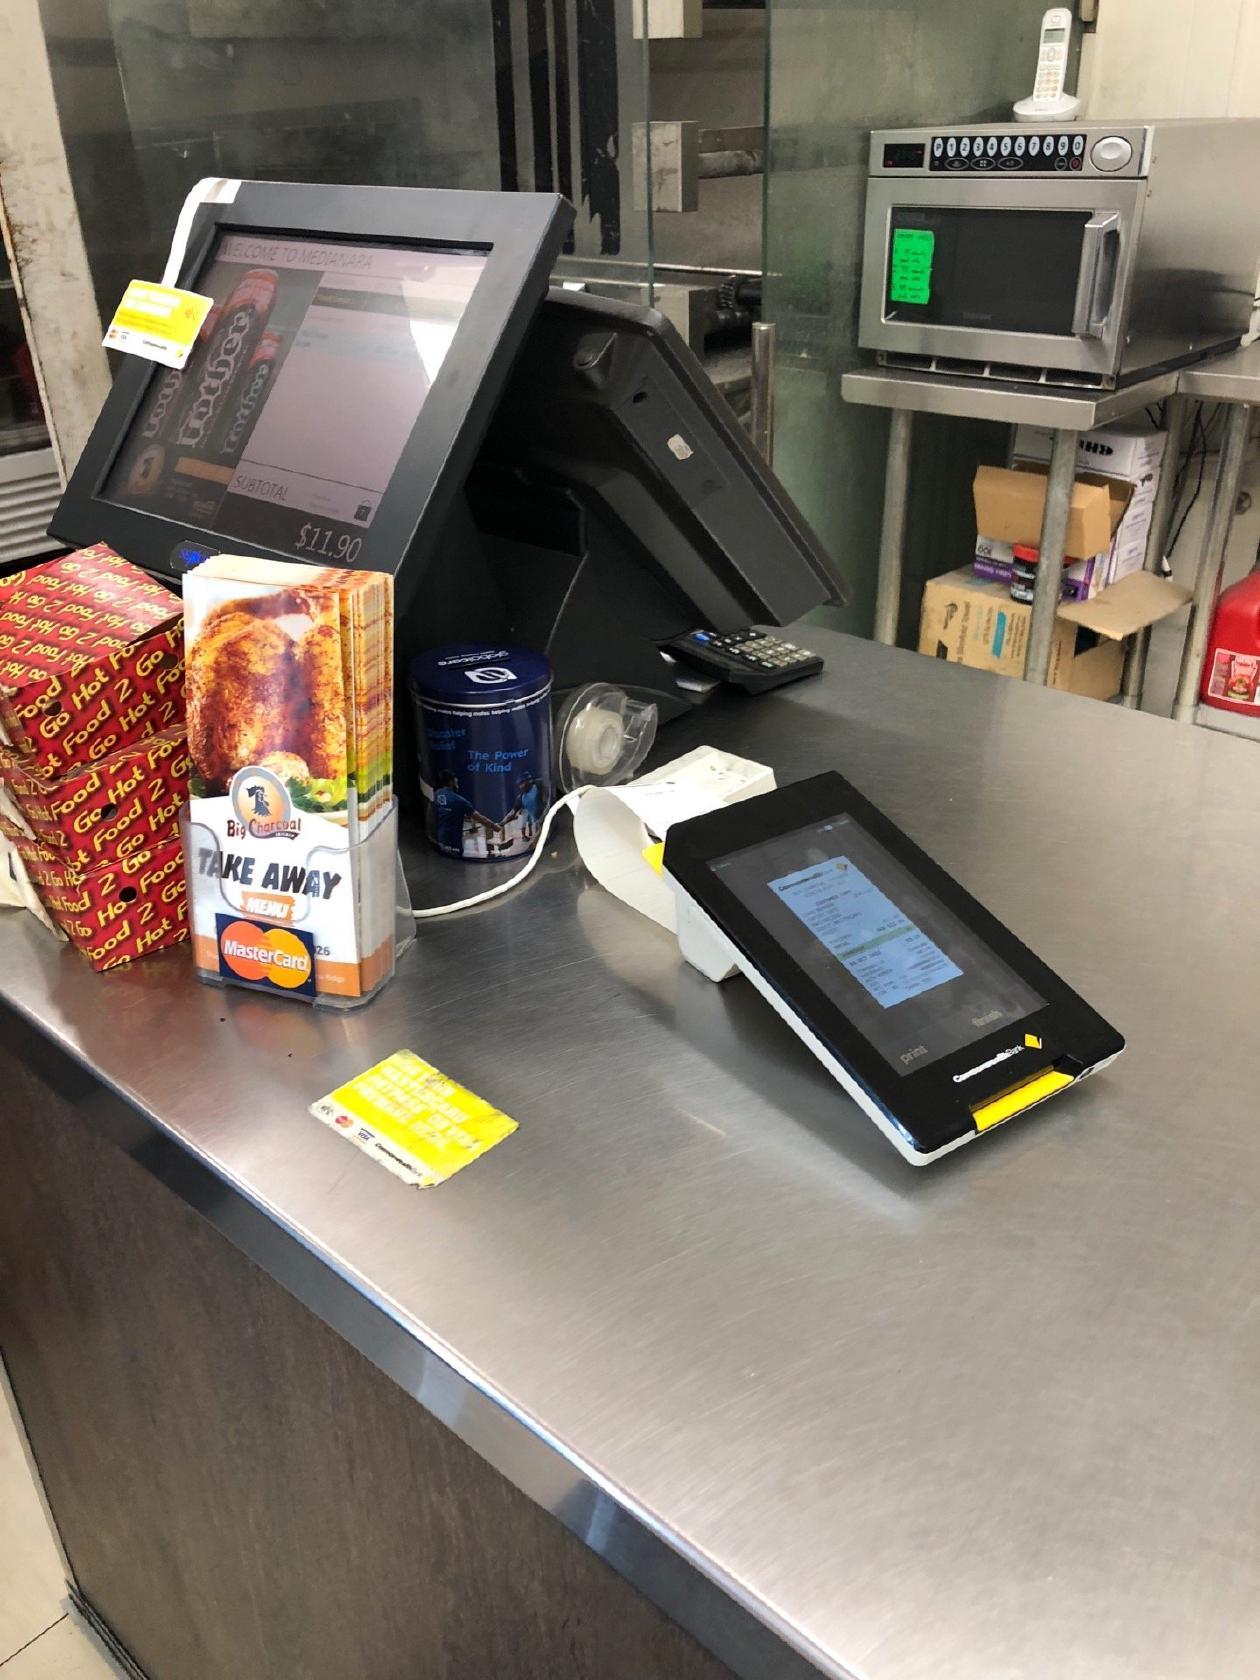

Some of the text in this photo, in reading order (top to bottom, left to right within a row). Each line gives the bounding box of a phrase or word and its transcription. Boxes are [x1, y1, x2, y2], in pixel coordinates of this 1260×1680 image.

[283, 246, 297, 262] TO
[233, 474, 289, 501] SUBTOTAL
[295, 522, 362, 563] $11.90
[61, 562, 82, 573] Go
[78, 568, 100, 579] 2
[95, 571, 140, 588] Food
[137, 582, 168, 597] Hot
[27, 574, 178, 620] Food 2 Go Hot Food
[27, 594, 46, 608] Go
[43, 599, 64, 613] 2
[57, 603, 103, 622] Food
[99, 613, 132, 630] Hot
[0, 611, 128, 649] ood 2 Go Hot Food
[129, 622, 153, 636] Go
[12, 639, 33, 655] 2
[25, 643, 67, 663] Food
[39, 711, 70, 738] Go
[71, 667, 110, 711] Hot
[62, 650, 165, 756] Food 2 Go
[89, 734, 117, 760] Go
[119, 691, 157, 732] Hot
[467, 748, 529, 761] The Power
[467, 762, 513, 774] of Kind
[50, 771, 101, 821] Food
[108, 765, 145, 806] Hot
[93, 797, 144, 853] Food
[147, 777, 166, 803] 2
[116, 792, 184, 859] Go Hot
[227, 817, 302, 840] Big Charcoal
[98, 850, 152, 897] 2 Go
[197, 847, 343, 900] TAKE AWAY
[97, 898, 128, 928] Ho
[137, 902, 155, 925] 2
[245, 896, 290, 918] MENU
[136, 916, 173, 953] Hot
[223, 939, 309, 971] MasterCard
[900, 1044, 929, 1065] print
